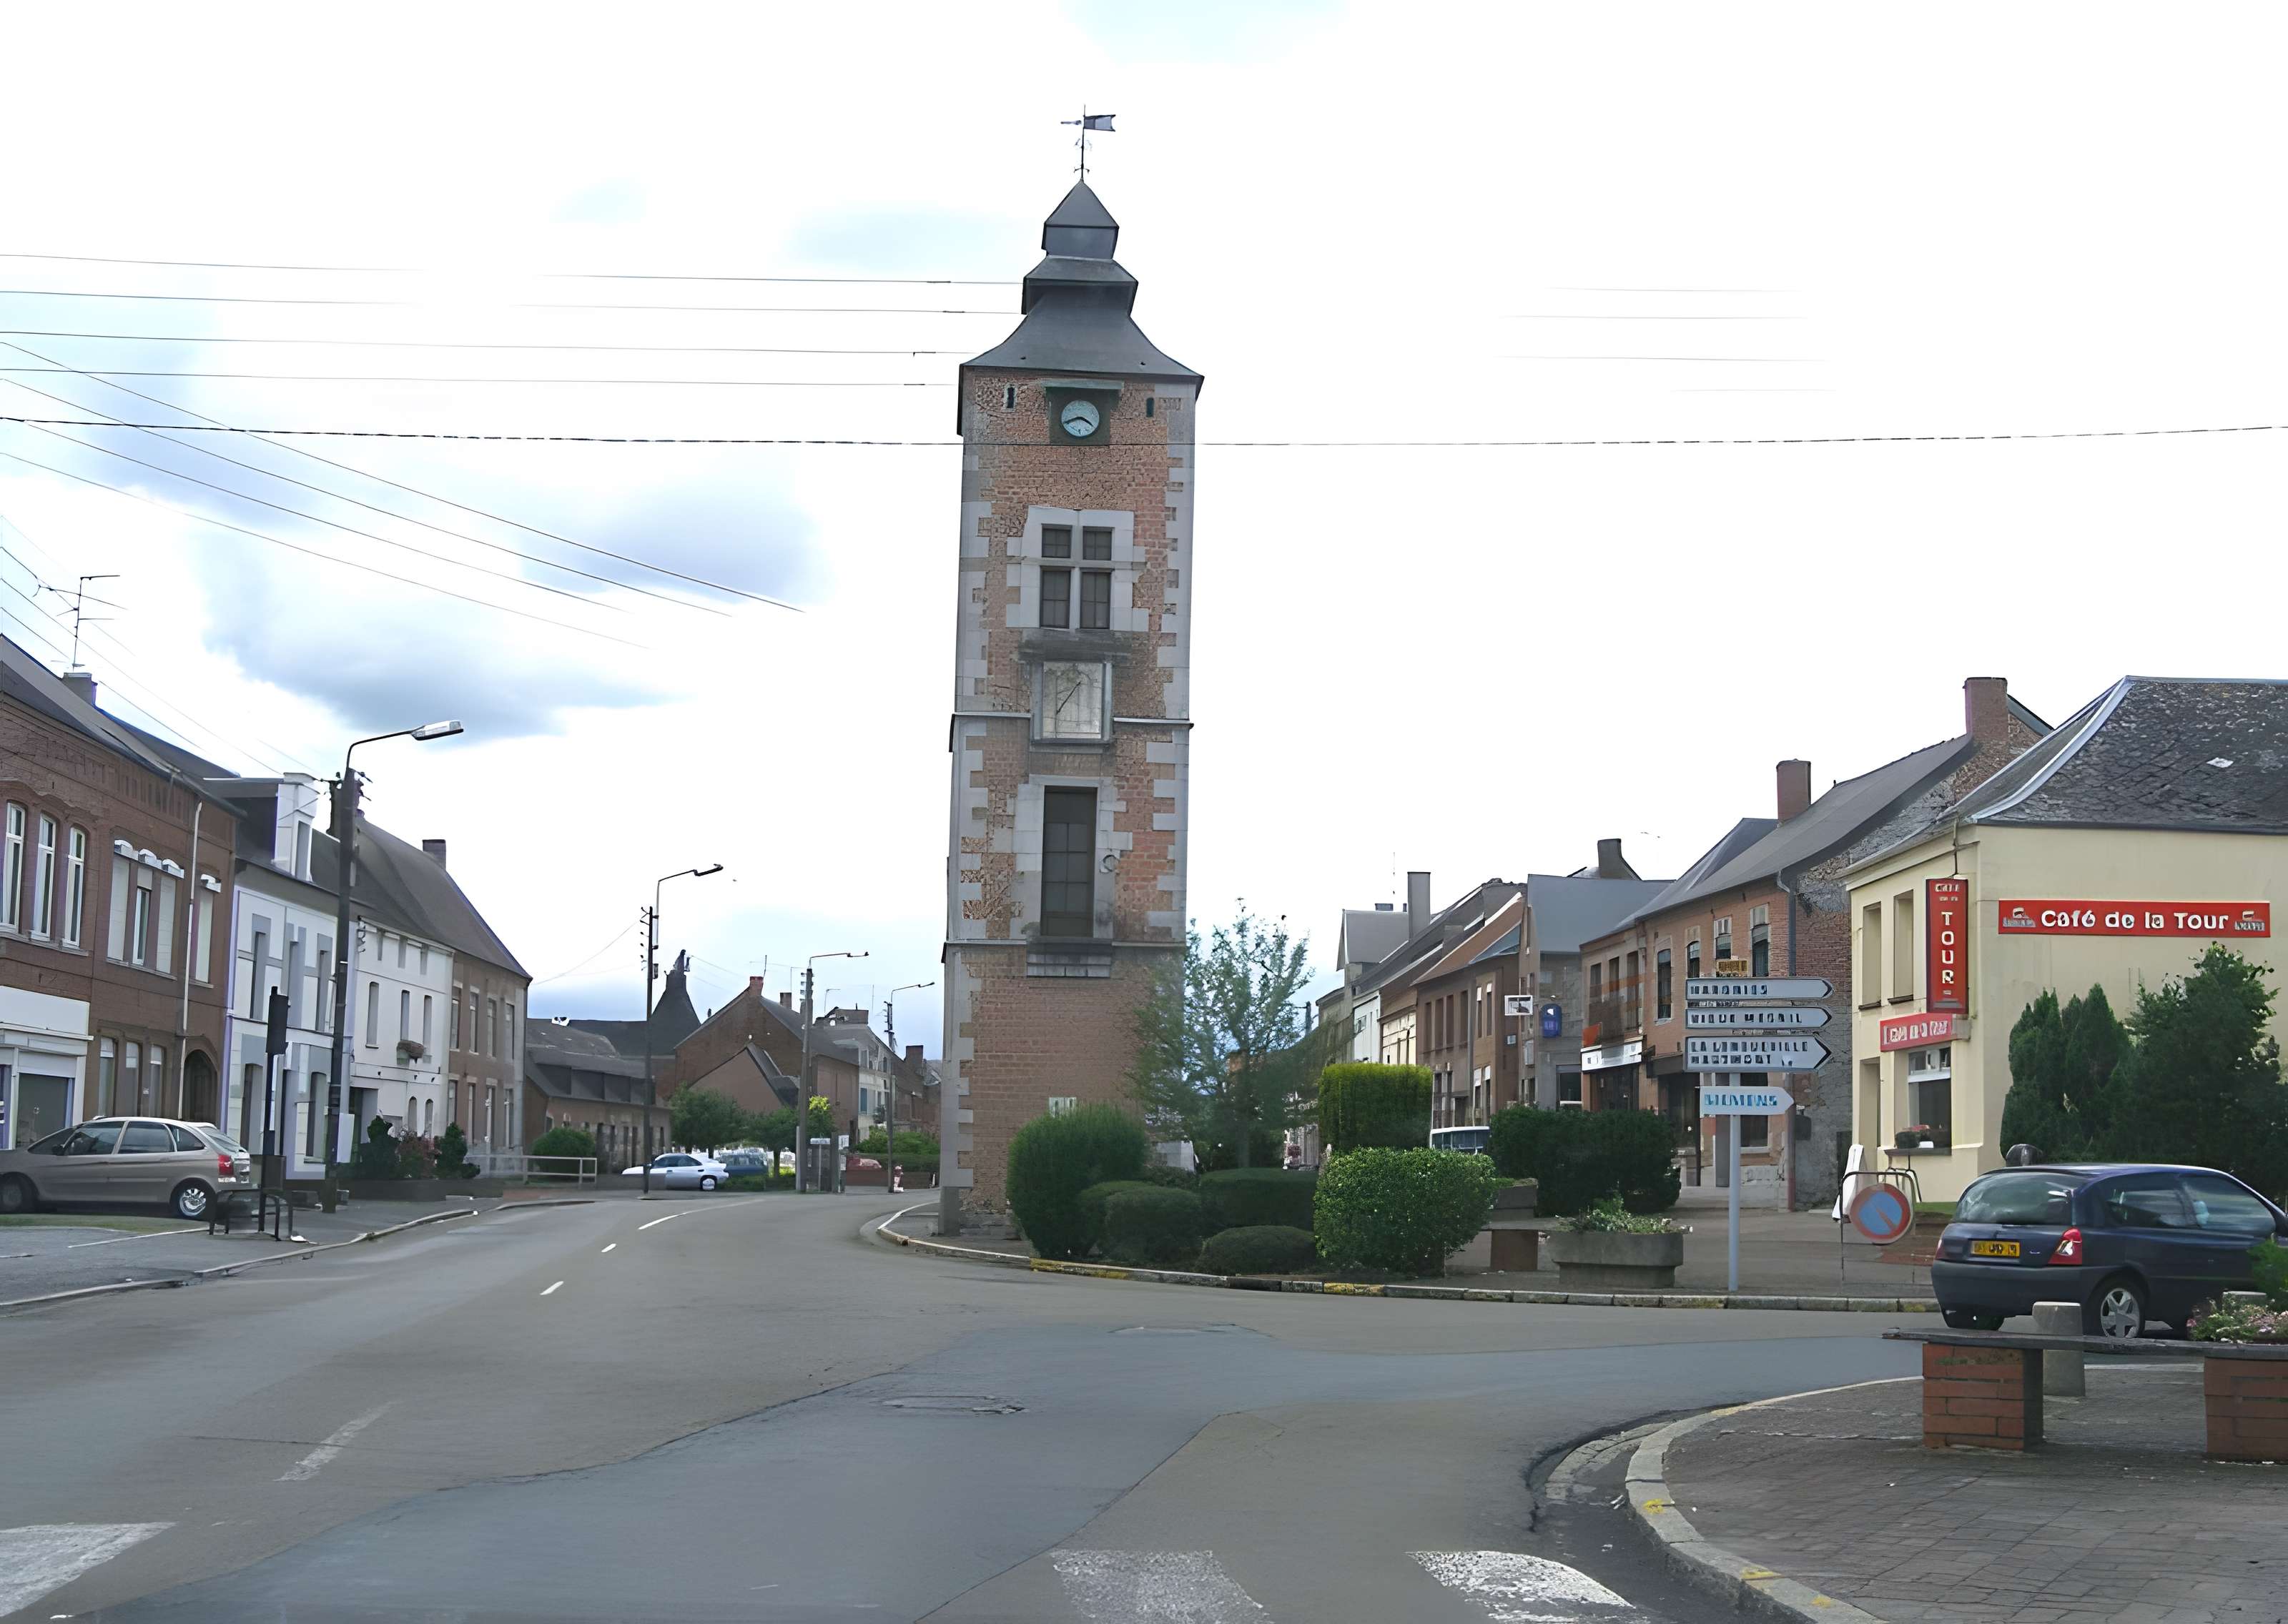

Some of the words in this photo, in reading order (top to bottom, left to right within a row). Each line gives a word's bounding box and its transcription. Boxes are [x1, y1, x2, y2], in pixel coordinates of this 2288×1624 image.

[2105, 911, 2135, 929] de
[2145, 911, 2164, 929] la
[2174, 912, 2229, 929] Tour
[1941, 911, 1955, 984] TOUR
